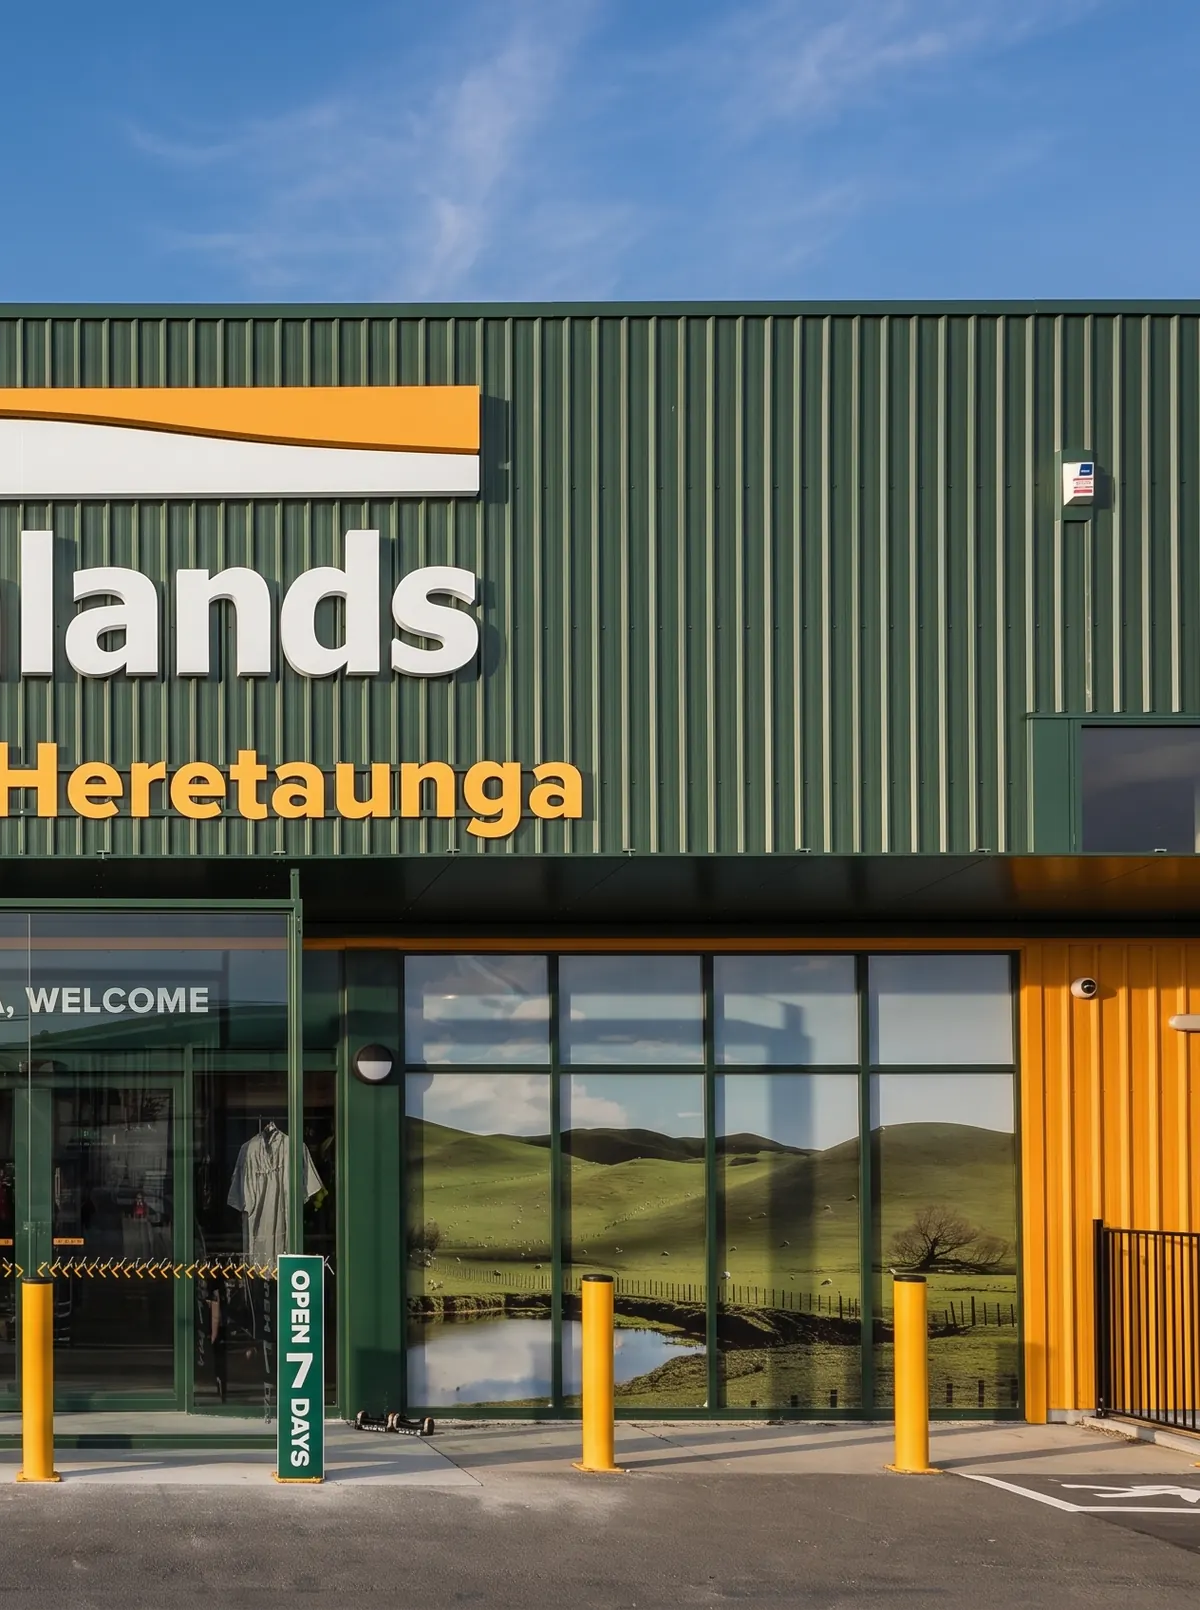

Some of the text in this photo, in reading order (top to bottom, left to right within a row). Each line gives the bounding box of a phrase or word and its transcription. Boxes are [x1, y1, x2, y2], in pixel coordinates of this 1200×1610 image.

[25, 987, 209, 1014] WELCOME
[286, 1269, 314, 1467] OPEN 7 DAYS
